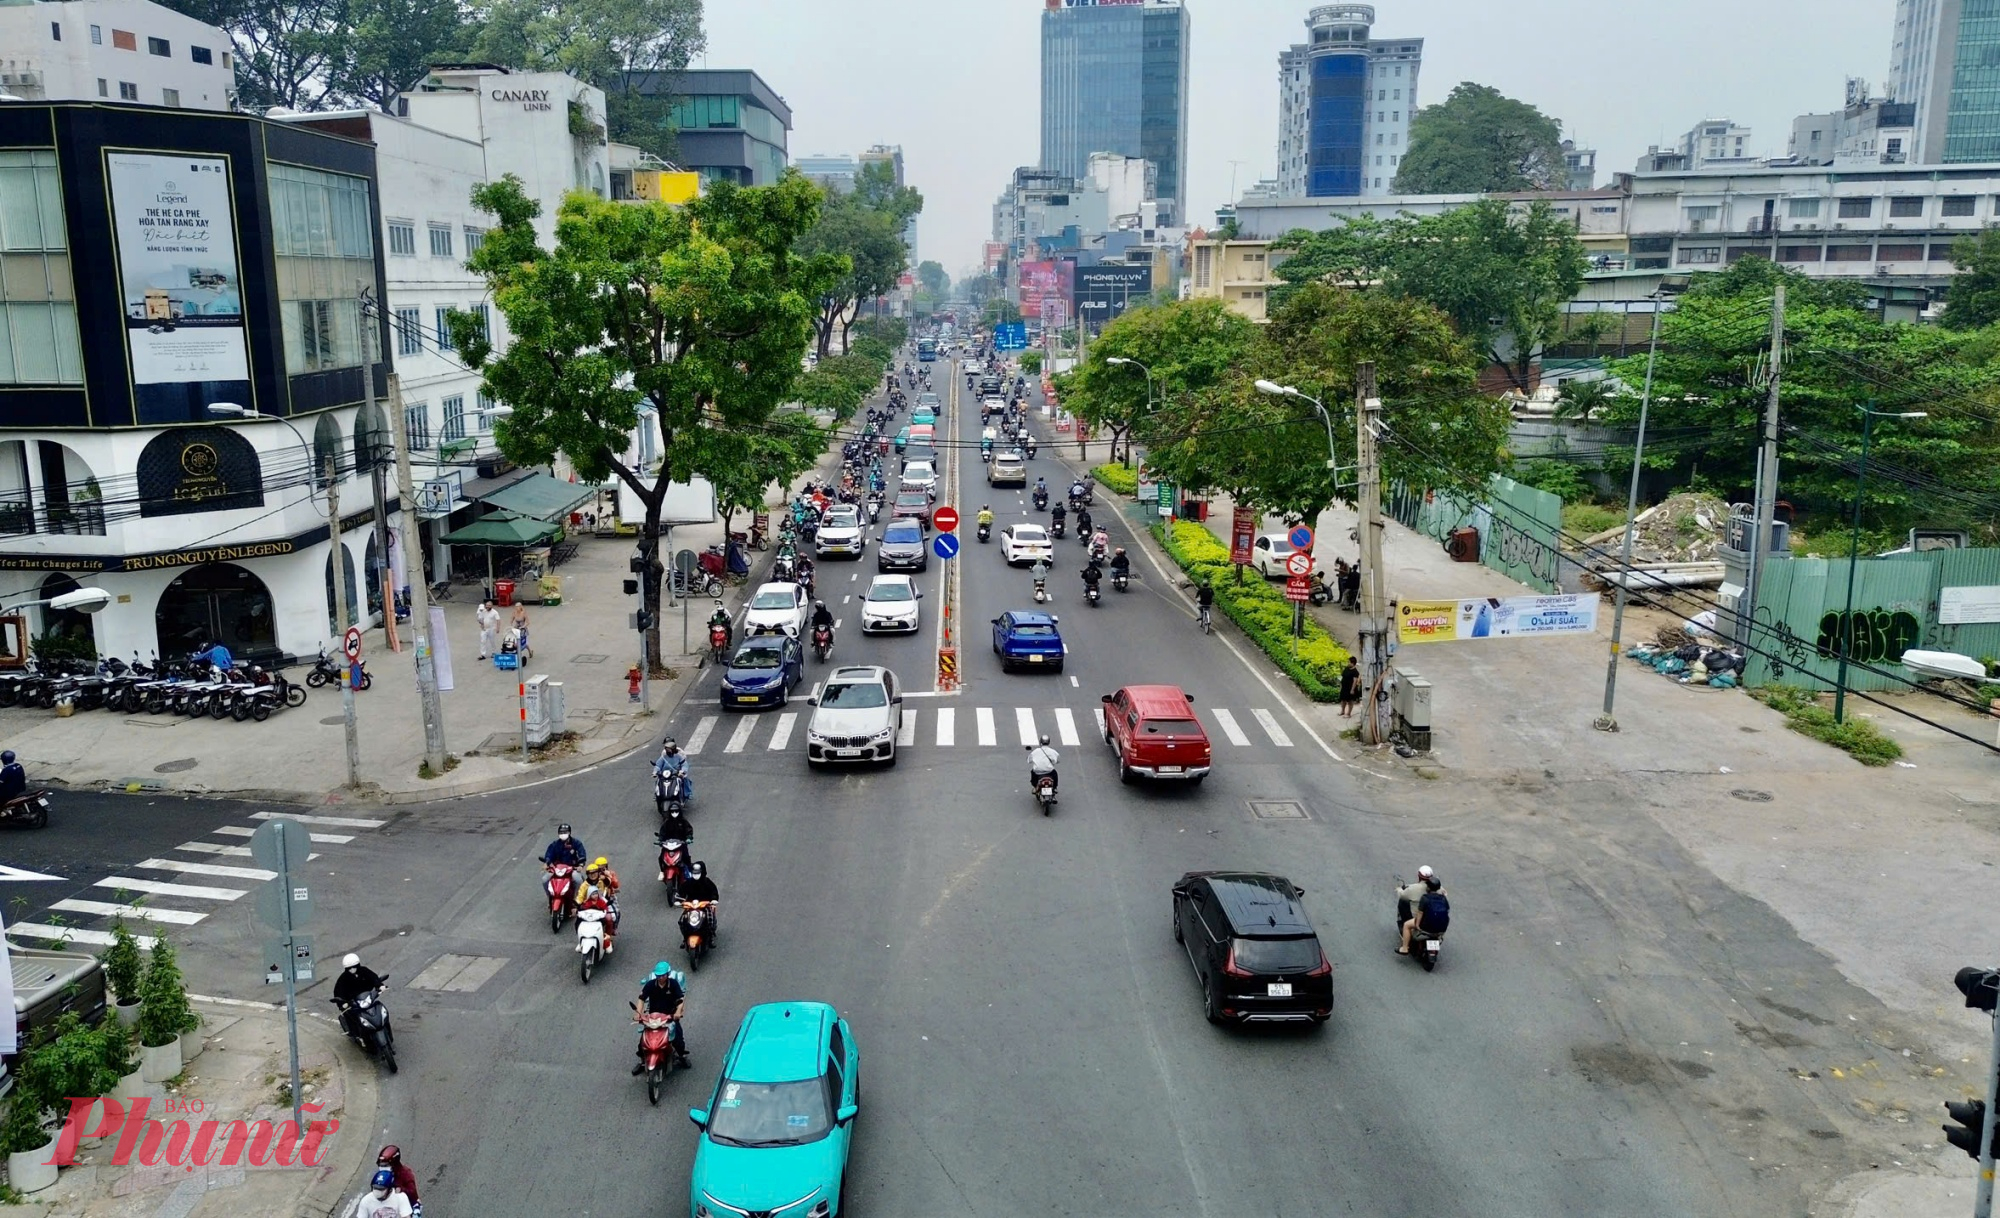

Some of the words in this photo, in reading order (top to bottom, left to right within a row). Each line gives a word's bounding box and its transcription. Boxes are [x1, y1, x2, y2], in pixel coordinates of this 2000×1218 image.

[492, 90, 548, 101] CANARY
[524, 103, 551, 111] LINEN
[156, 194, 188, 204] Legend
[42, 560, 80, 569] Changes
